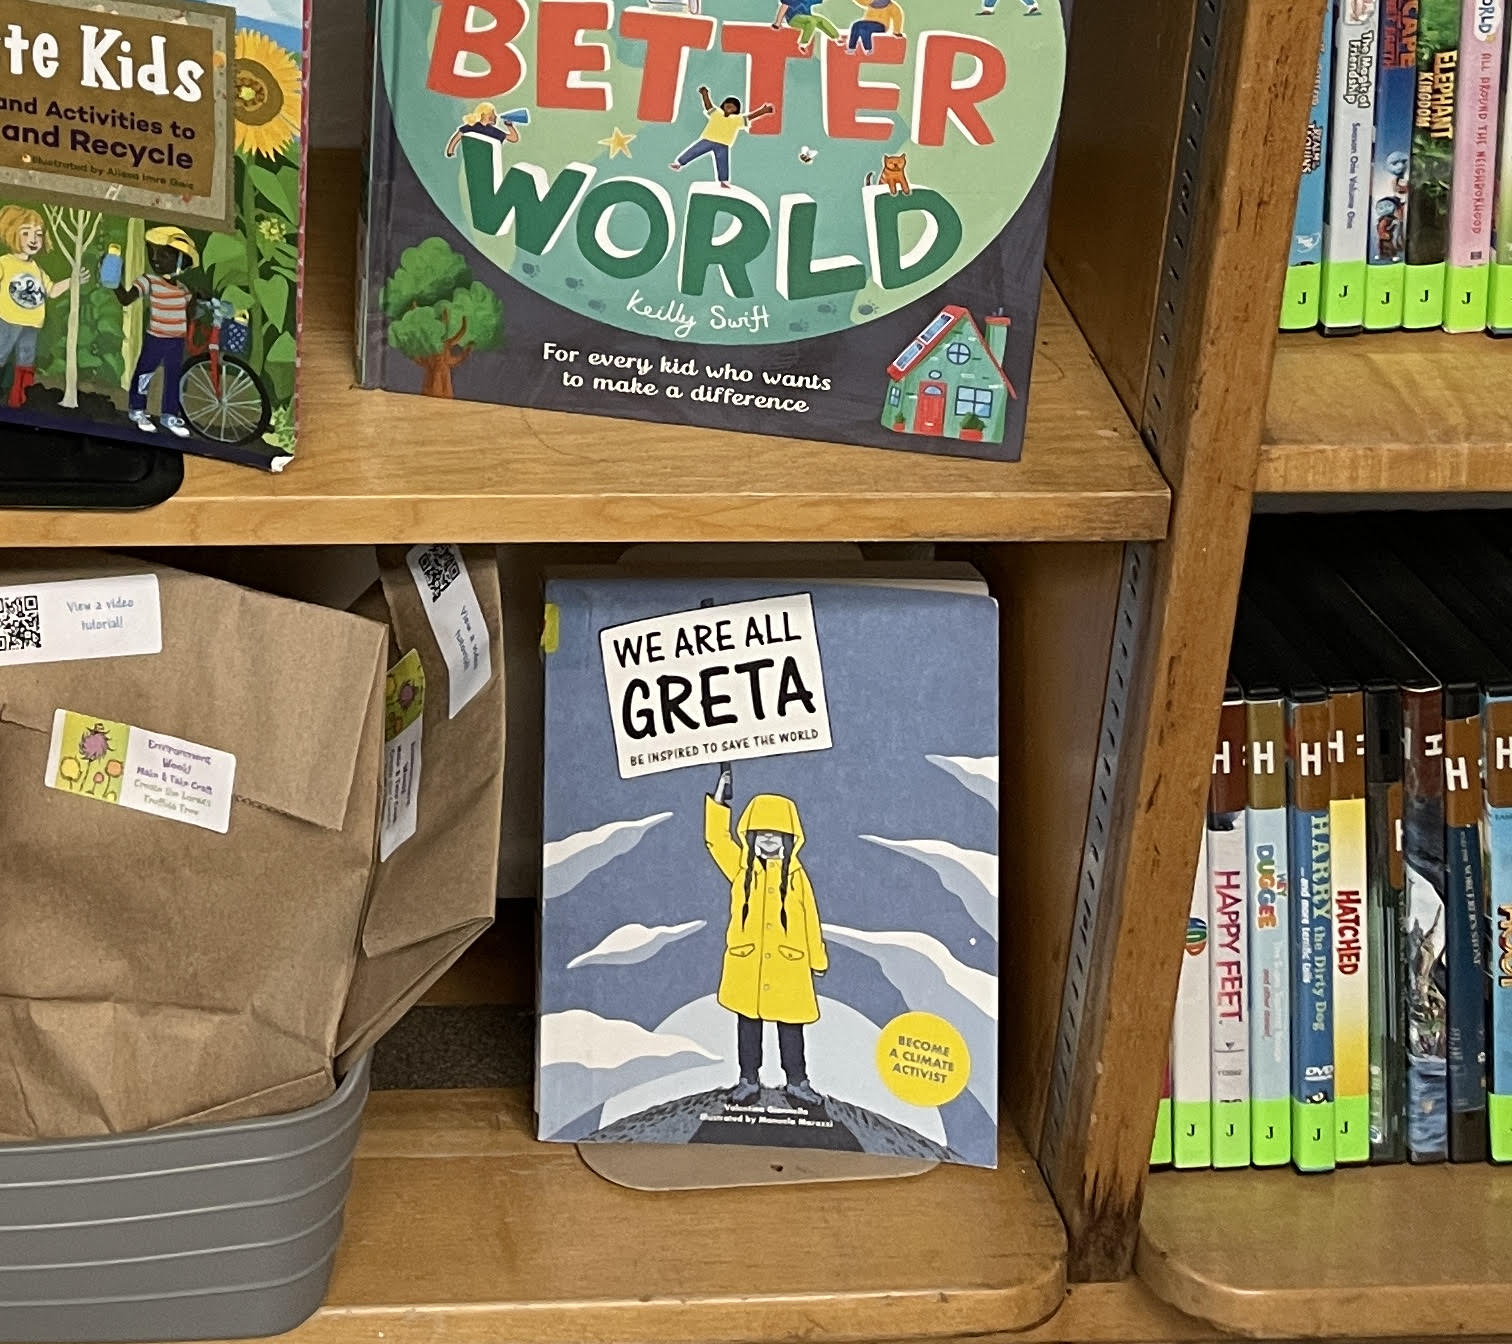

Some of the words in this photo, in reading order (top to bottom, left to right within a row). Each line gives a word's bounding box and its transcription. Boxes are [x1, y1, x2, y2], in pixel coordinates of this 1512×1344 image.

[79, 23, 204, 103] Kids
[1, 121, 60, 149] and
[69, 133, 194, 171] Recycle
[461, 133, 963, 300] WORLD
[614, 631, 666, 668] WE
[674, 619, 734, 659] ARE
[745, 611, 801, 646] ALL
[622, 656, 816, 740] GRETA
[630, 754, 645, 766] BE
[648, 745, 699, 763] INSPIRED
[703, 742, 718, 754] TO
[721, 737, 750, 752] SAVE
[753, 734, 775, 747] THE
[779, 728, 818, 744] WORLD
[1214, 870, 1242, 954] HAPPY
[1335, 890, 1361, 975] HATCHED
[1216, 960, 1243, 1022] FEET
[889, 1049, 899, 1059] A
[902, 1051, 955, 1073] CLIMATE
[892, 1062, 948, 1083] ACTIVIST
[898, 1035, 950, 1057] BECOME
